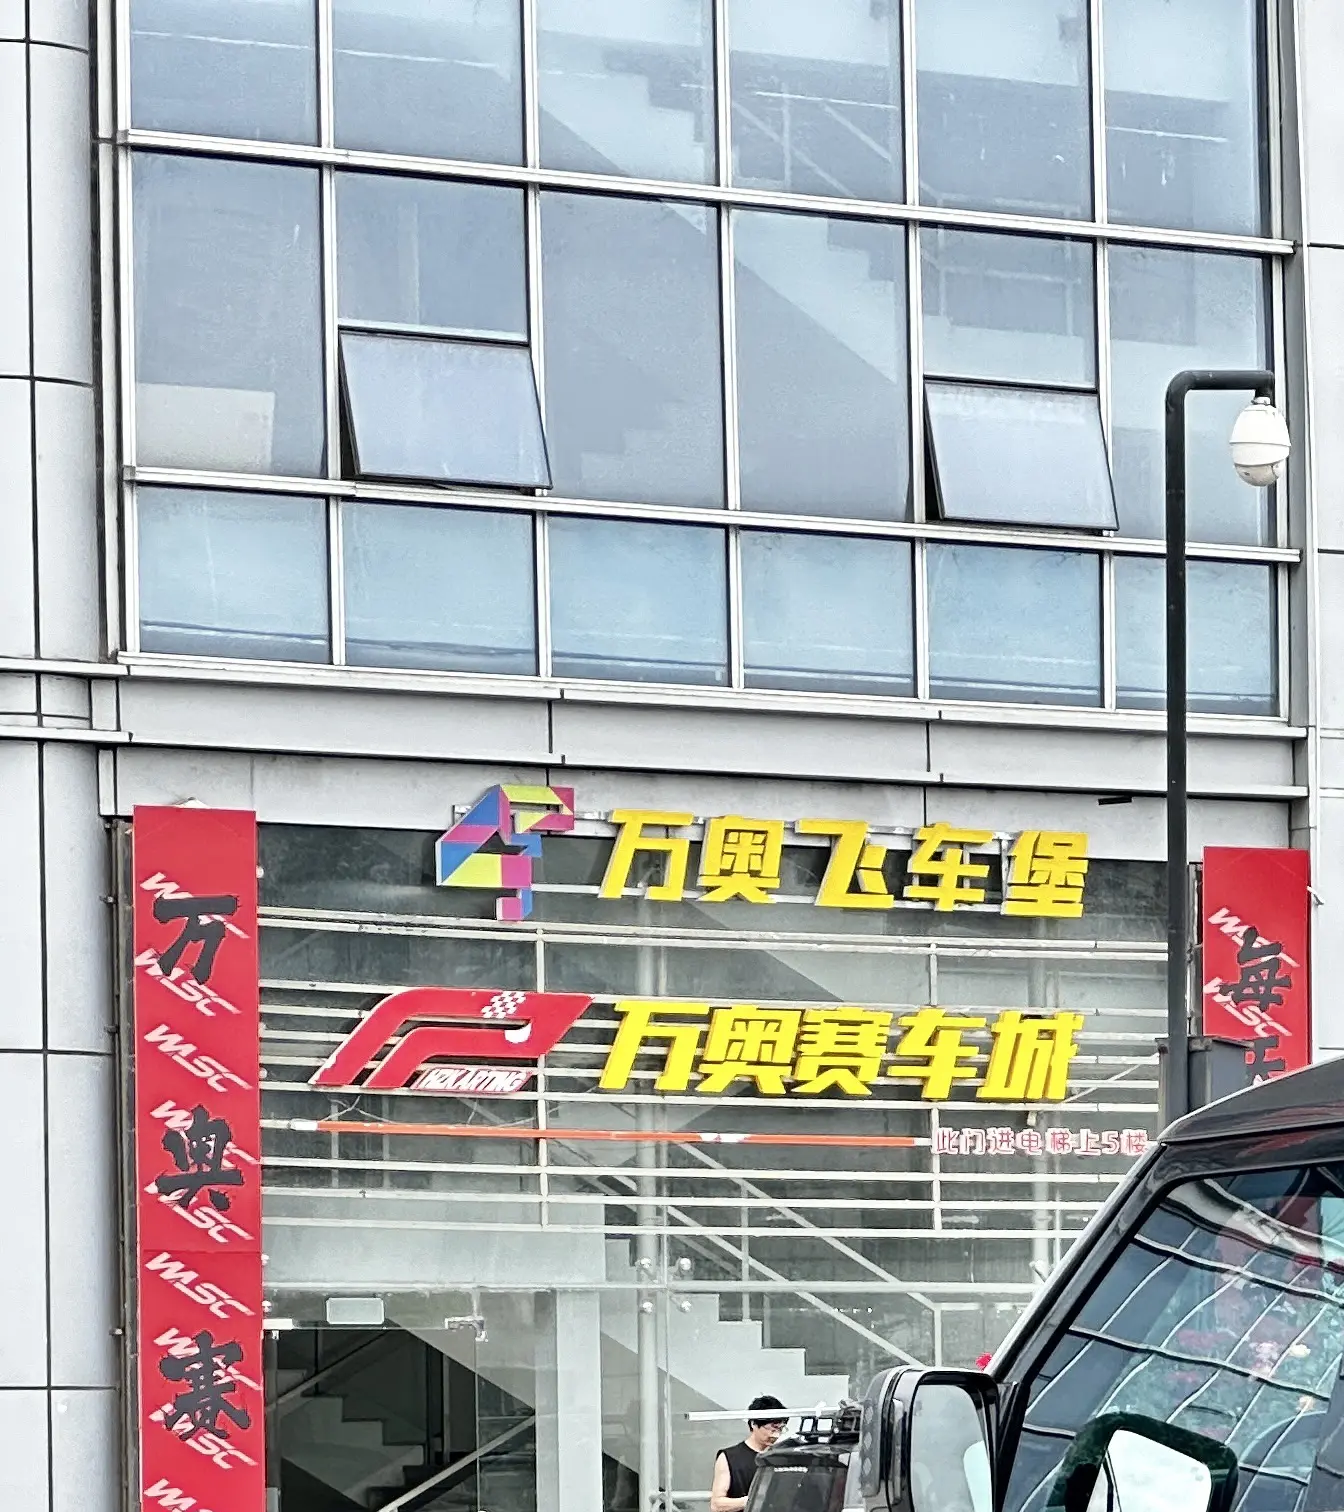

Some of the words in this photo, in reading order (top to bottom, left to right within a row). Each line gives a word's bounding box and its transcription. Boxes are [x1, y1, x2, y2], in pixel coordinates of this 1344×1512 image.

[598, 808, 1089, 918] 万奥飞车堡
[598, 997, 1085, 1102] 万奥赛车城
[932, 1126, 1149, 1156] 此门进电梯上5楼
